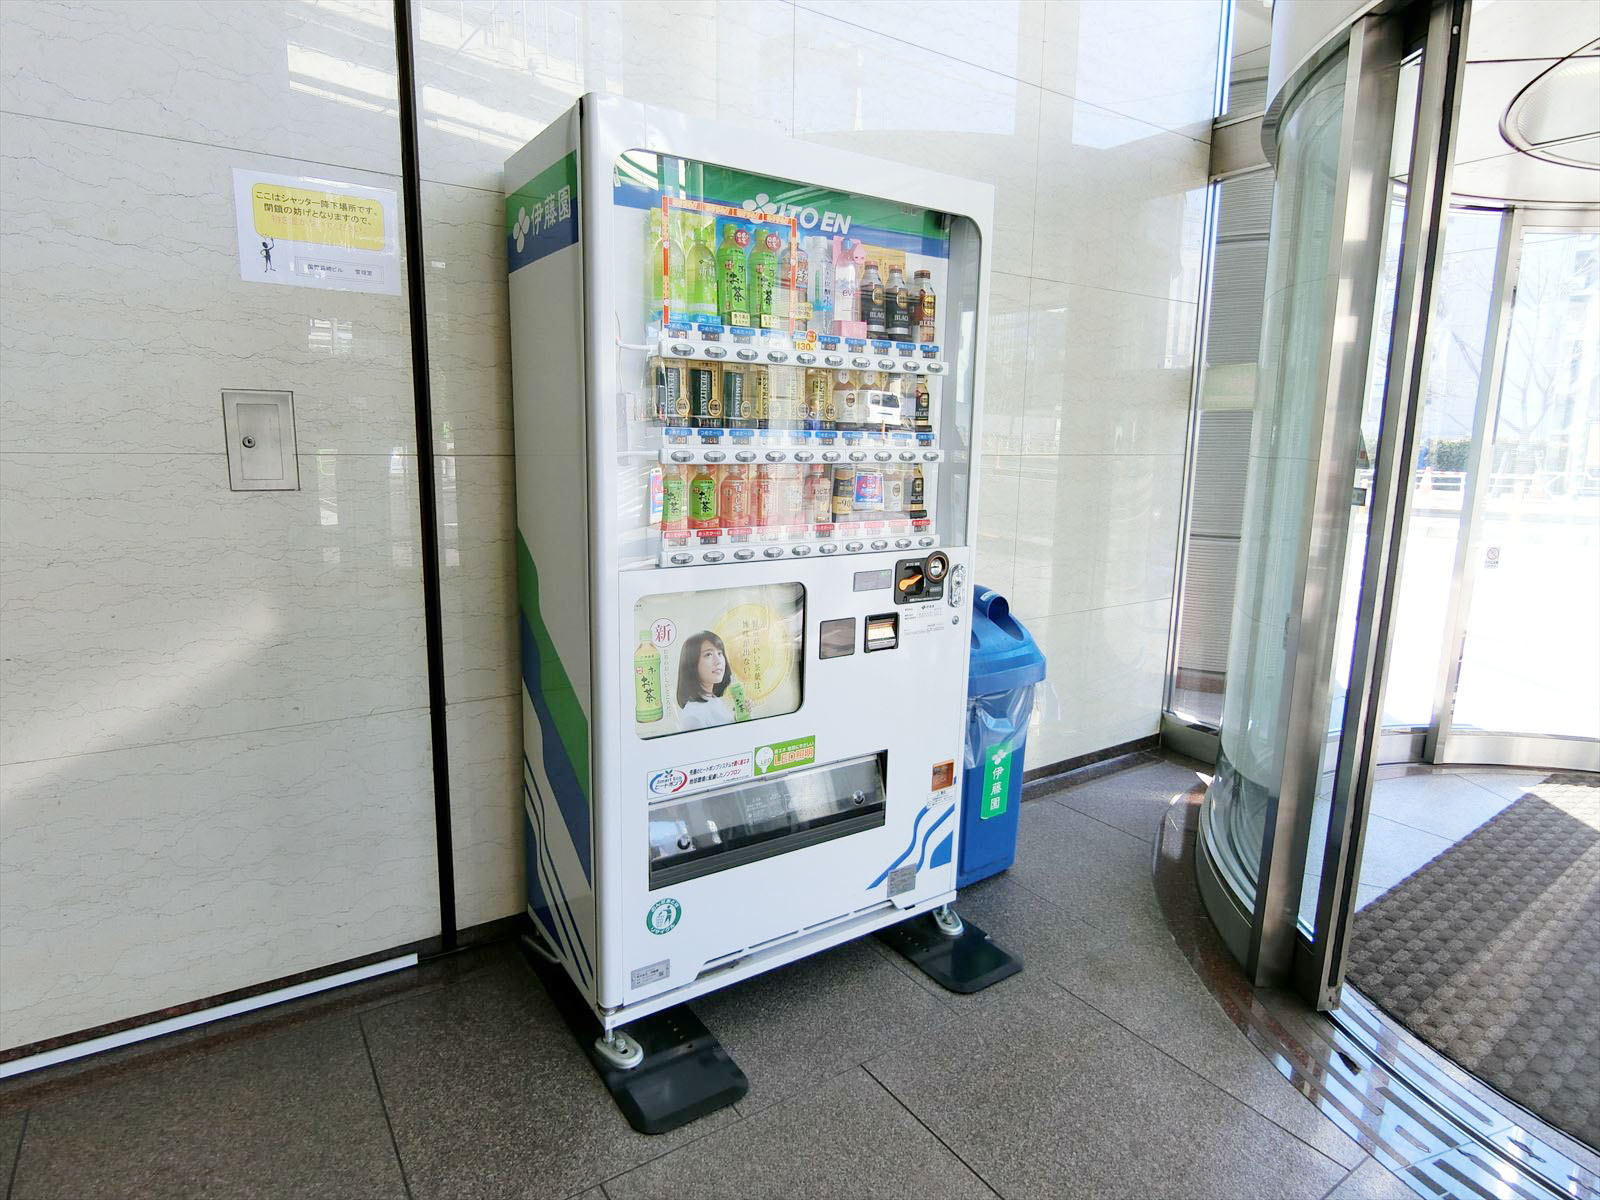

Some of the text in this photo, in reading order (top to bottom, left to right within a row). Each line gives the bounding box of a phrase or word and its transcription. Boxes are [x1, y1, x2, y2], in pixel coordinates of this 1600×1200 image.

[531, 185, 571, 236] 伊藤園
[820, 210, 852, 234] EN
[655, 624, 671, 643] 新
[990, 766, 1004, 811] 伊藤園
